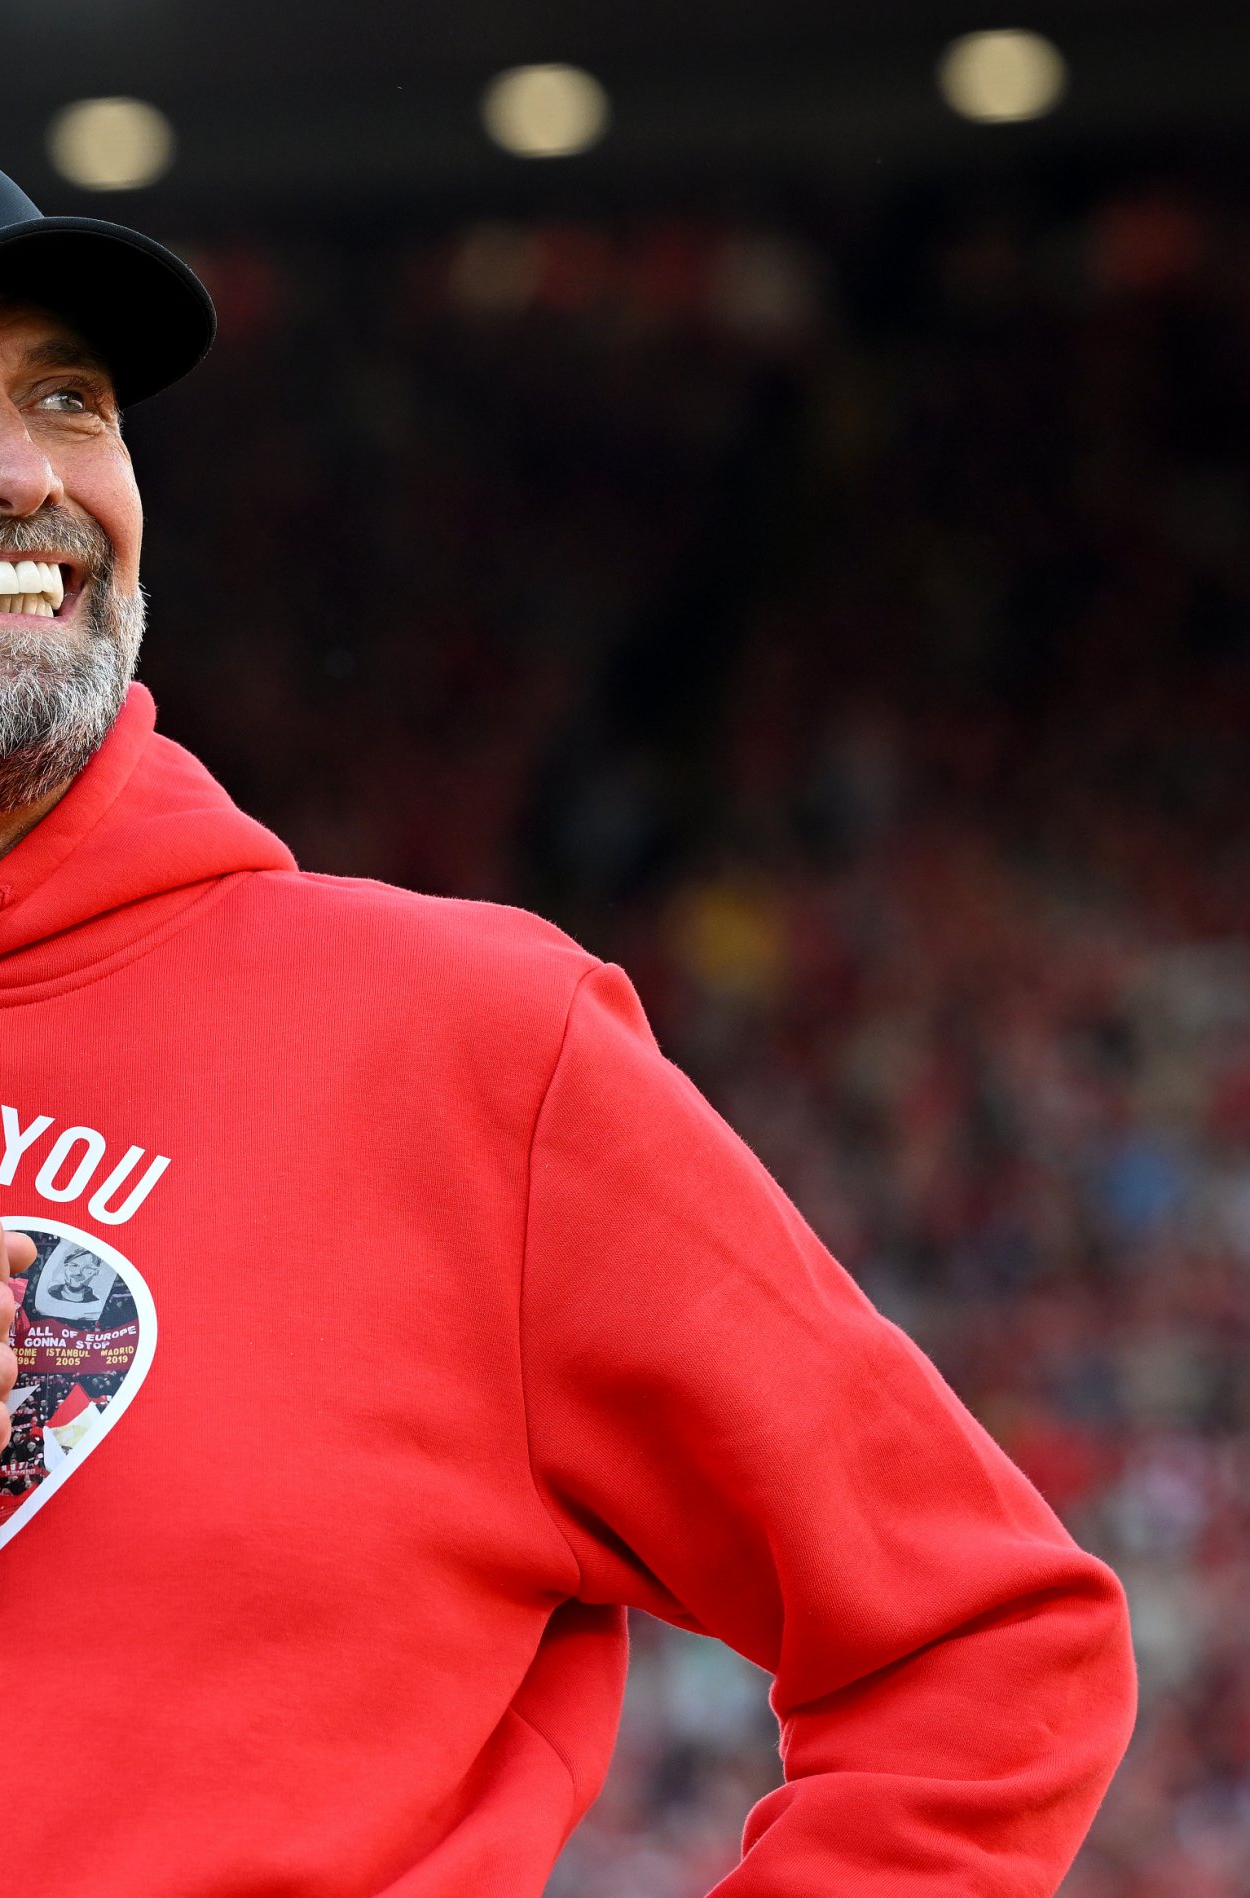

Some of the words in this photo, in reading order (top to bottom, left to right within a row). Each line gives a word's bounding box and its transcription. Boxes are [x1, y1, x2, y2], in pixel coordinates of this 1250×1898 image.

[28, 1326, 53, 1337] ALL
[62, 1329, 78, 1339] OF
[86, 1325, 137, 1342] EUROPE
[24, 1337, 67, 1348] GONNA
[76, 1341, 110, 1350] STOP
[46, 1348, 90, 1358] ISTANBUL
[100, 1346, 134, 1357] MADRID
[17, 1356, 35, 1365] 984
[56, 1358, 80, 1366] 2005
[106, 1355, 128, 1365] 2019
